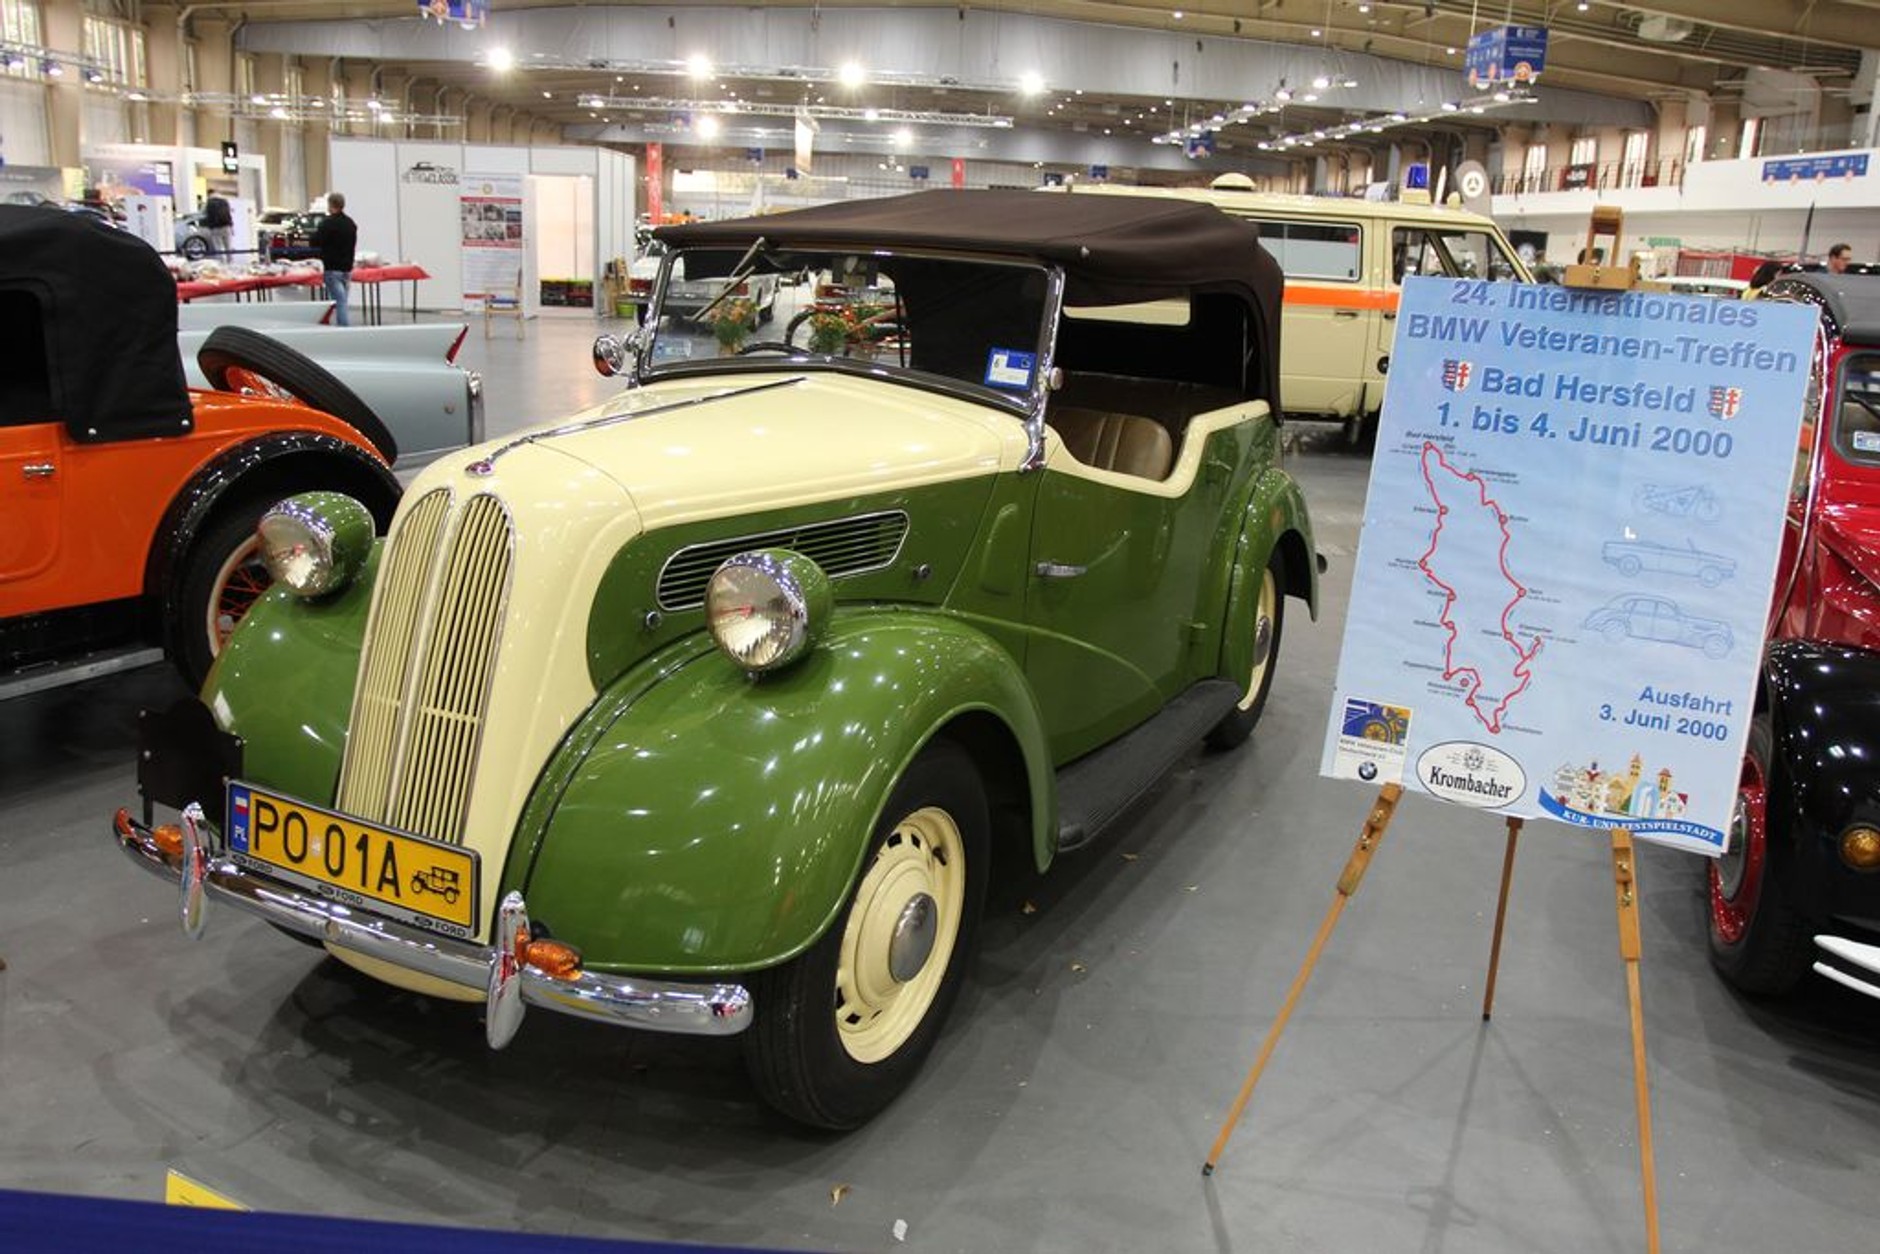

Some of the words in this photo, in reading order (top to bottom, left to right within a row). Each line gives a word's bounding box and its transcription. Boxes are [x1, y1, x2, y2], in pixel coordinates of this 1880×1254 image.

[1452, 281, 1495, 306] 24.
[1508, 283, 1758, 328] Internationales
[1408, 314, 1489, 342] BMW
[1500, 320, 1797, 373] Veteranen-Treffen
[1481, 366, 1543, 397] Bad
[1555, 375, 1696, 413] Hersfeld
[1437, 402, 1460, 428] 1.
[1472, 405, 1520, 434] bis
[1530, 411, 1557, 440] 4.
[1568, 417, 1642, 449] Juni
[1651, 426, 1732, 458] 2000
[1639, 686, 1732, 716] Ausfahrt
[1599, 704, 1617, 721] 3.
[1624, 709, 1670, 731] Juni
[1676, 717, 1728, 741] 2000
[1429, 765, 1513, 799] Krombacher
[235, 825, 247, 842] PL
[254, 798, 308, 865] PO
[324, 823, 401, 899] 01A
[334, 889, 364, 905] FORD
[435, 921, 466, 938] FORD
